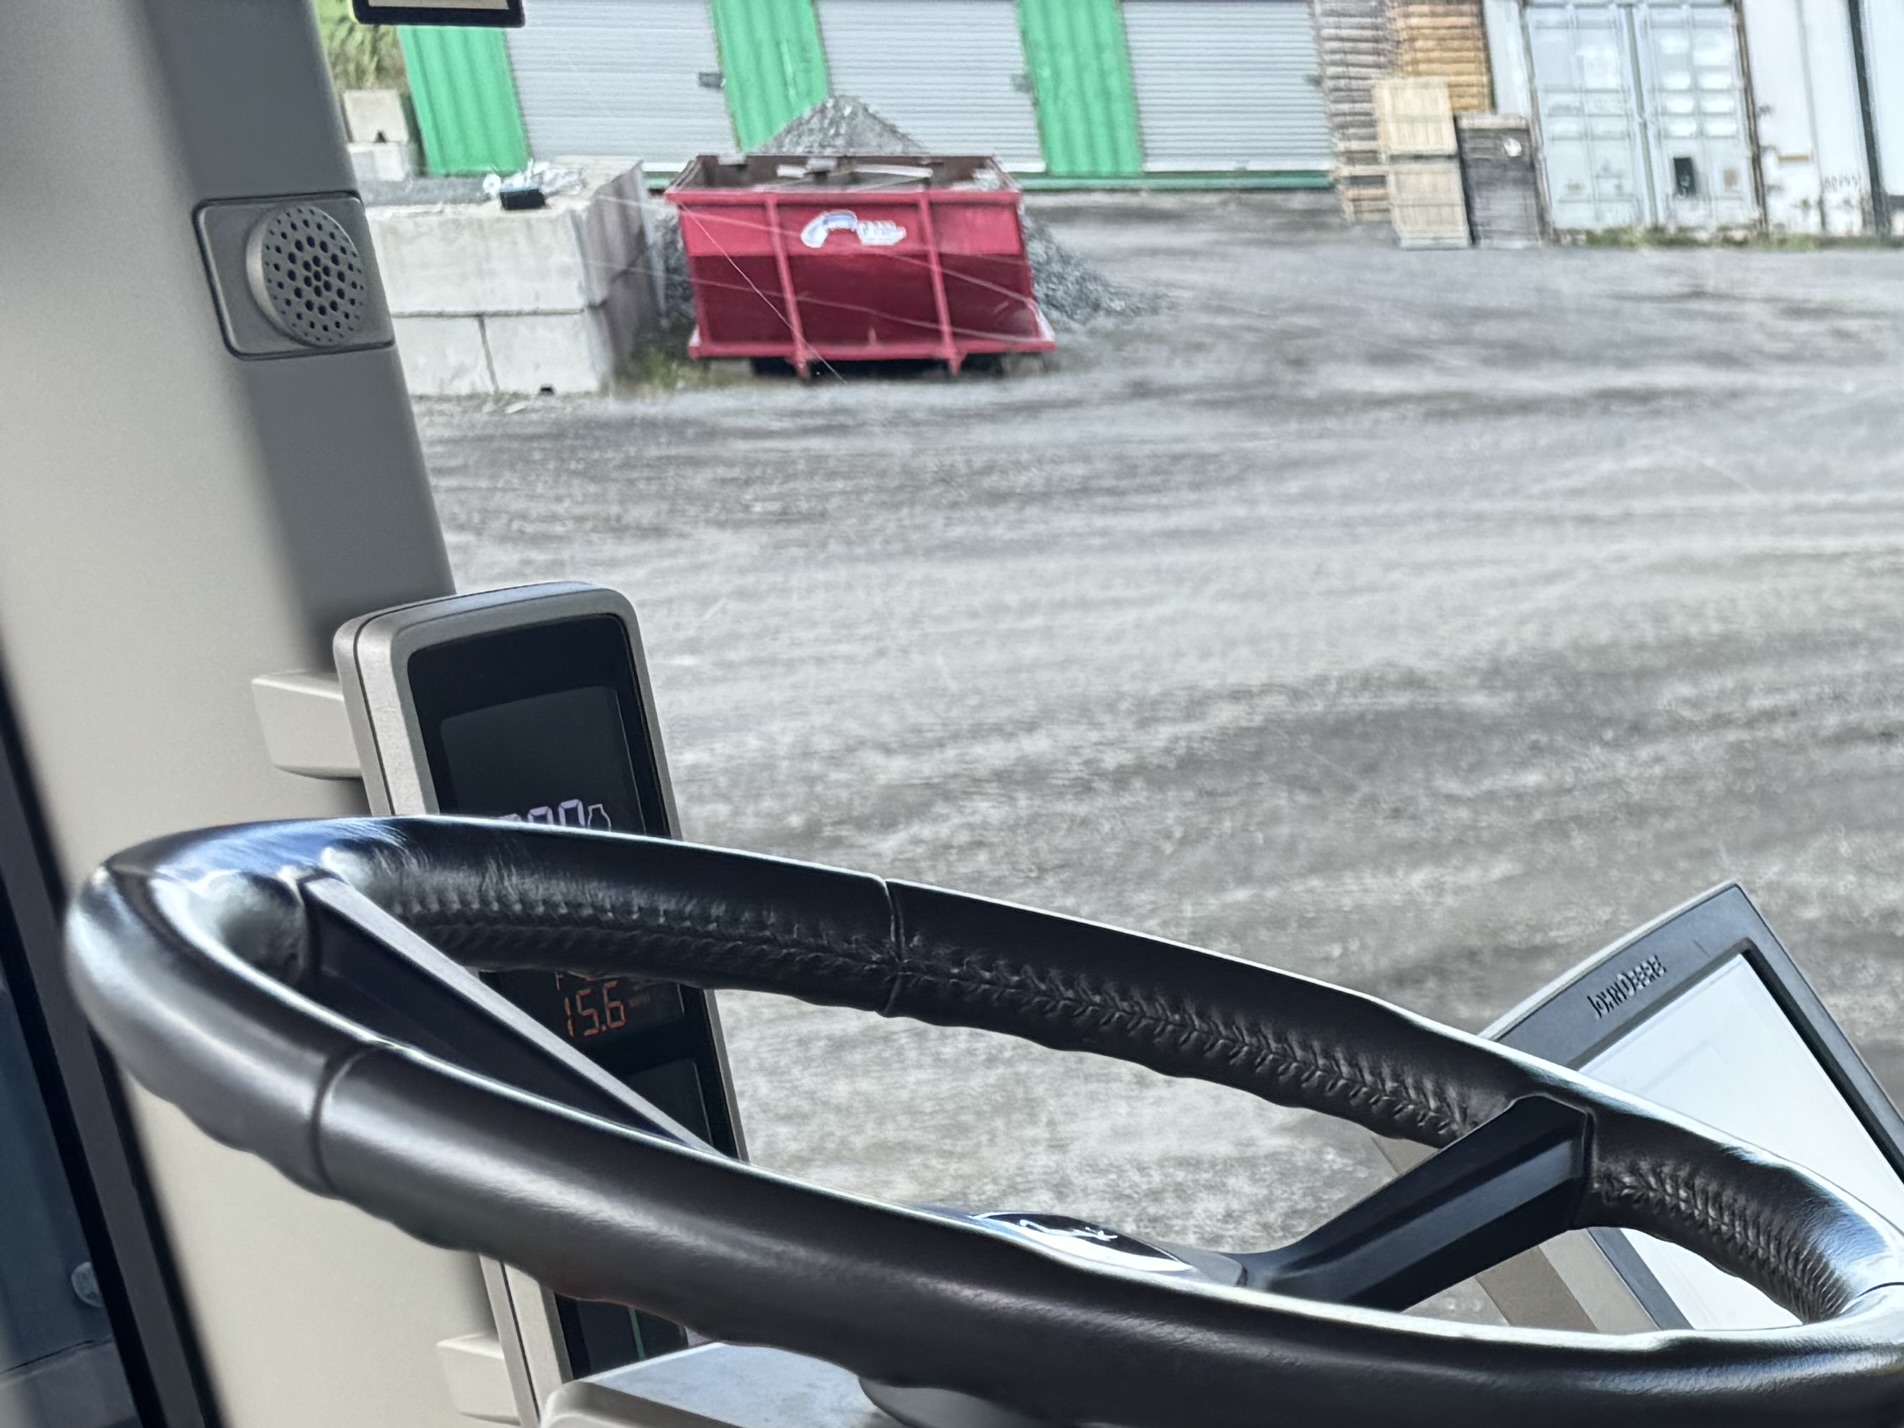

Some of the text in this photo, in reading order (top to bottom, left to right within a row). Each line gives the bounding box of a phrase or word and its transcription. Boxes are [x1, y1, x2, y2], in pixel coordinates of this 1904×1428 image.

[563, 980, 627, 1037] 15.6
[1586, 953, 1667, 1019] JOHN DEERE
